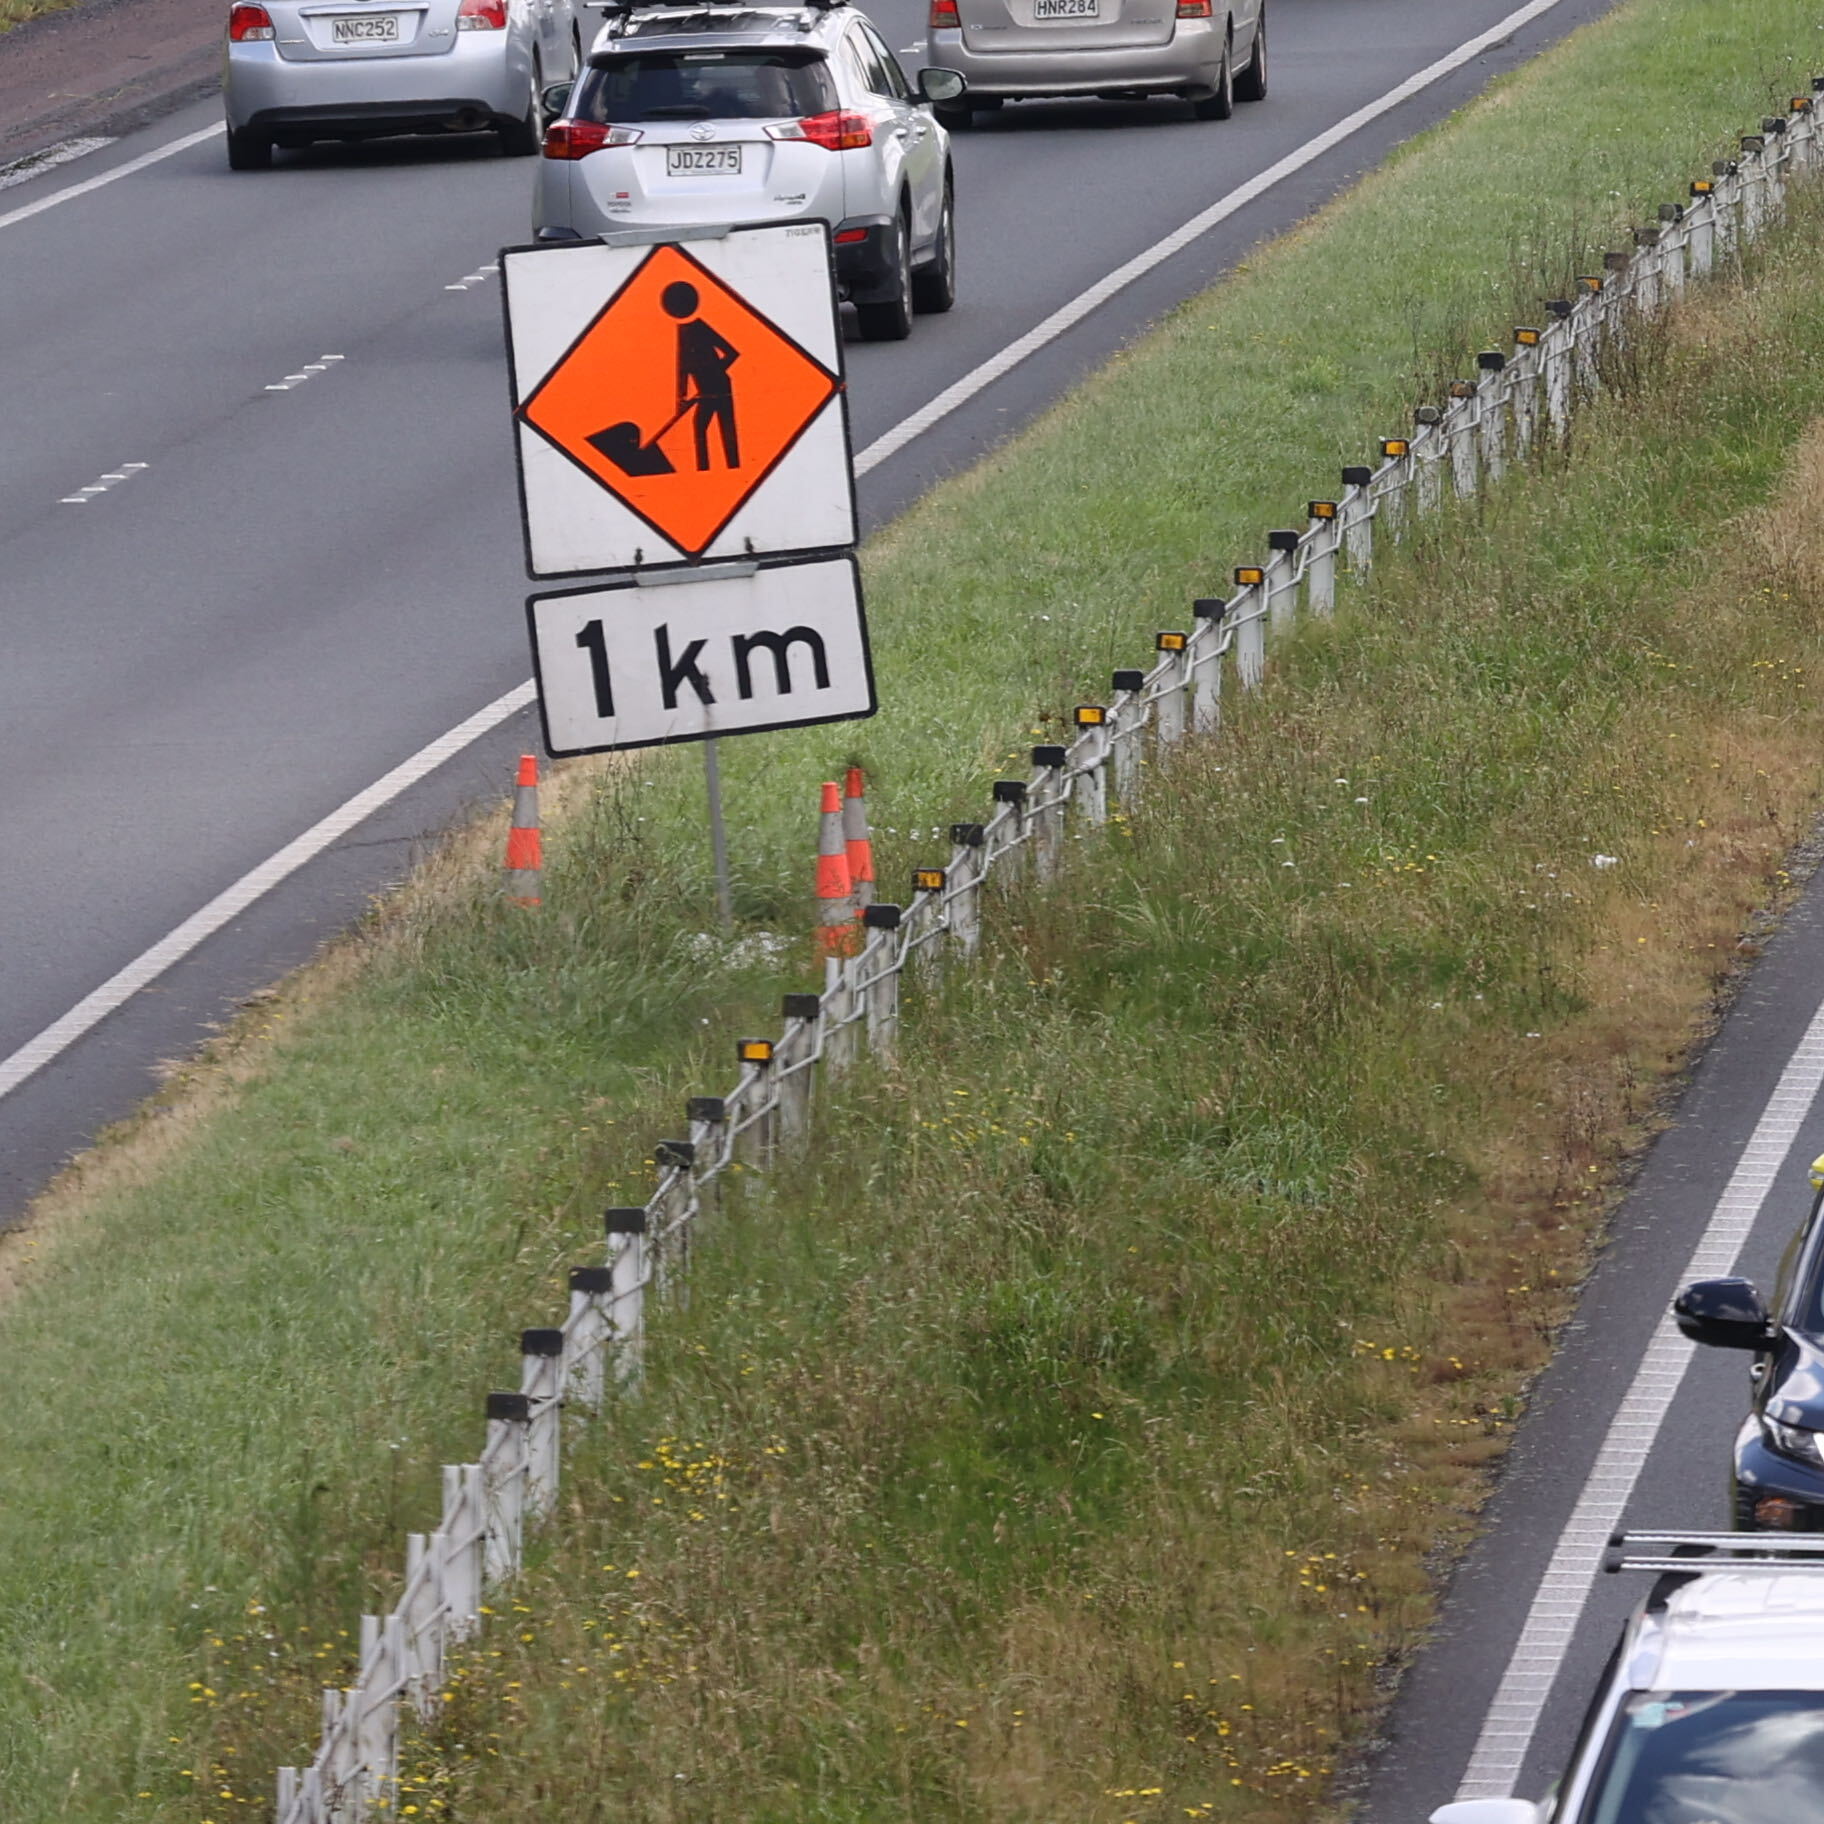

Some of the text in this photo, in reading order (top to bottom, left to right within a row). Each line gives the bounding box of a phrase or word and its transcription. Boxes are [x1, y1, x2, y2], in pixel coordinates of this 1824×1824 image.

[1037, 0, 1096, 15] HNR284
[335, 20, 395, 39] NNC252
[671, 151, 738, 169] JDZ275
[575, 618, 833, 719] 1 km
